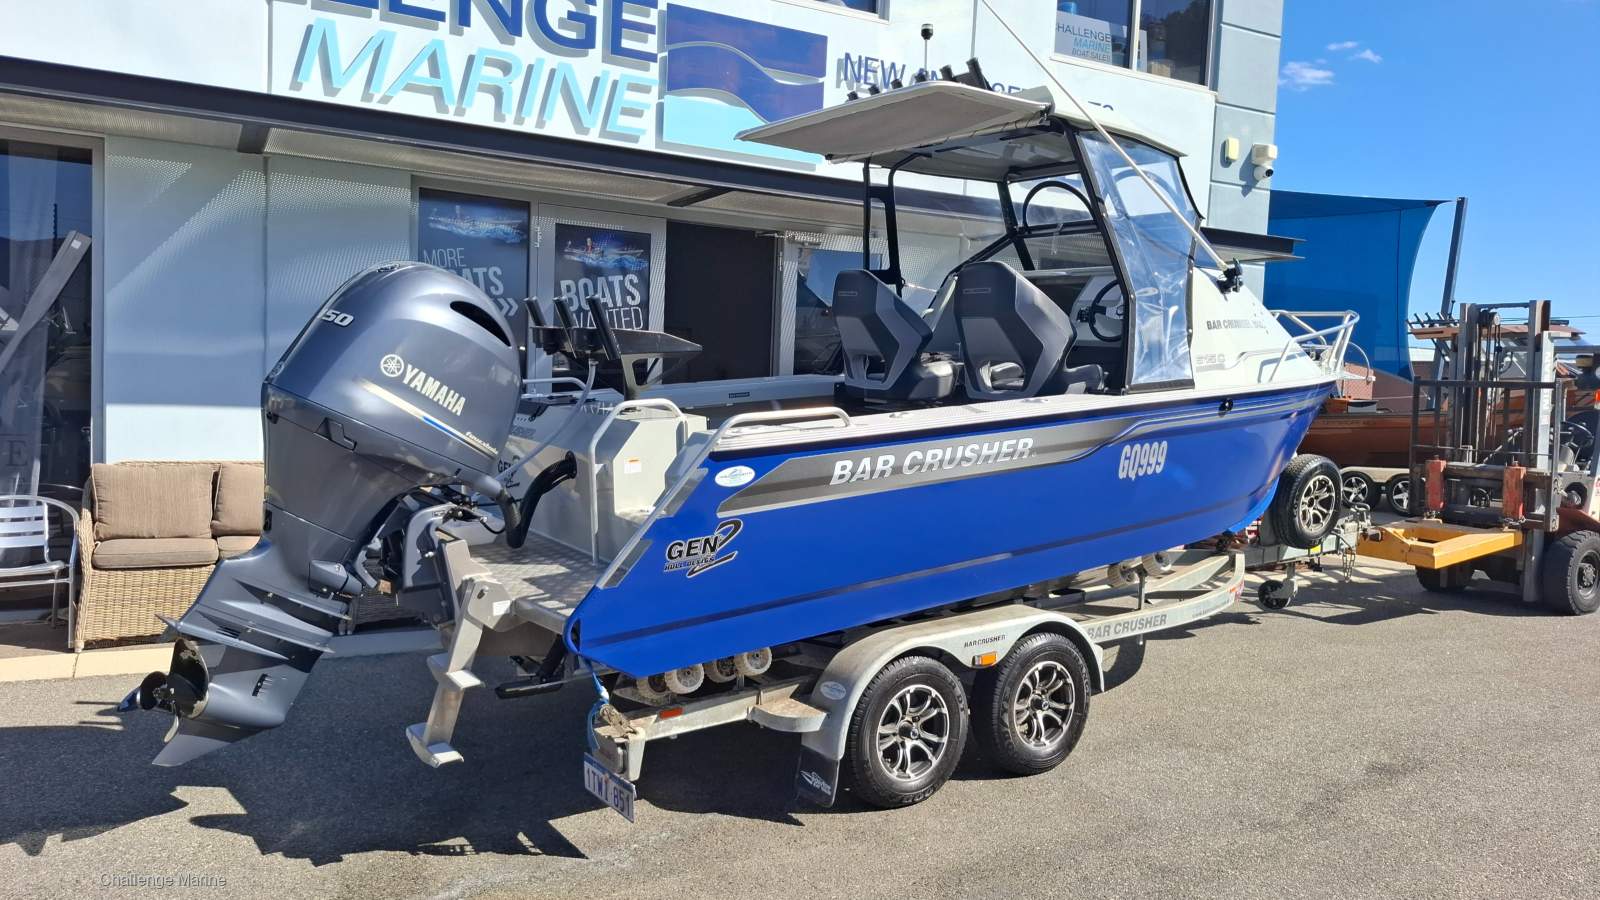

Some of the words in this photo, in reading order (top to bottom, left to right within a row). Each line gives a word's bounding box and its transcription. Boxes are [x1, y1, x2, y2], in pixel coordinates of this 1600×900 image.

[298, 18, 660, 136] MARINE
[844, 52, 906, 89] NEW
[423, 247, 466, 269] MORE
[560, 273, 641, 312] BOATS
[402, 364, 466, 416] YAMAHA
[829, 455, 895, 486] BAR
[902, 437, 1035, 475] CRUSHER
[1118, 440, 1168, 481] GQ999
[666, 535, 720, 561] GEN
[1113, 614, 1168, 635] CRUSHER
